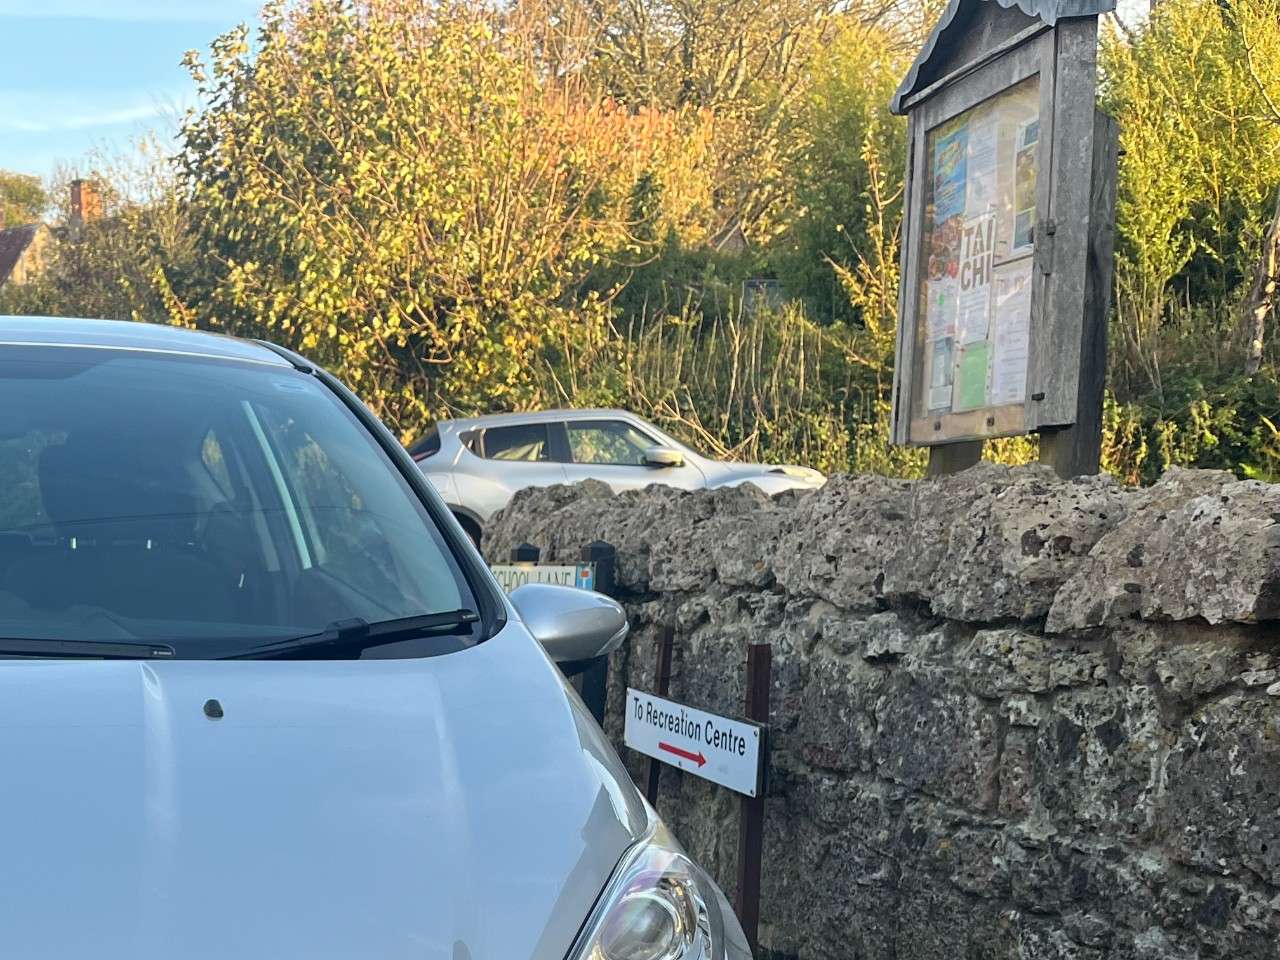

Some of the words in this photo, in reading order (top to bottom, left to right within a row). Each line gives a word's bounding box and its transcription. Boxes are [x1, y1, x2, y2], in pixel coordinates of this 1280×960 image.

[963, 218, 993, 259] TAI
[961, 251, 992, 291] CHI
[634, 697, 643, 721] To
[646, 702, 701, 742] Recreation
[704, 720, 746, 756] Centre
